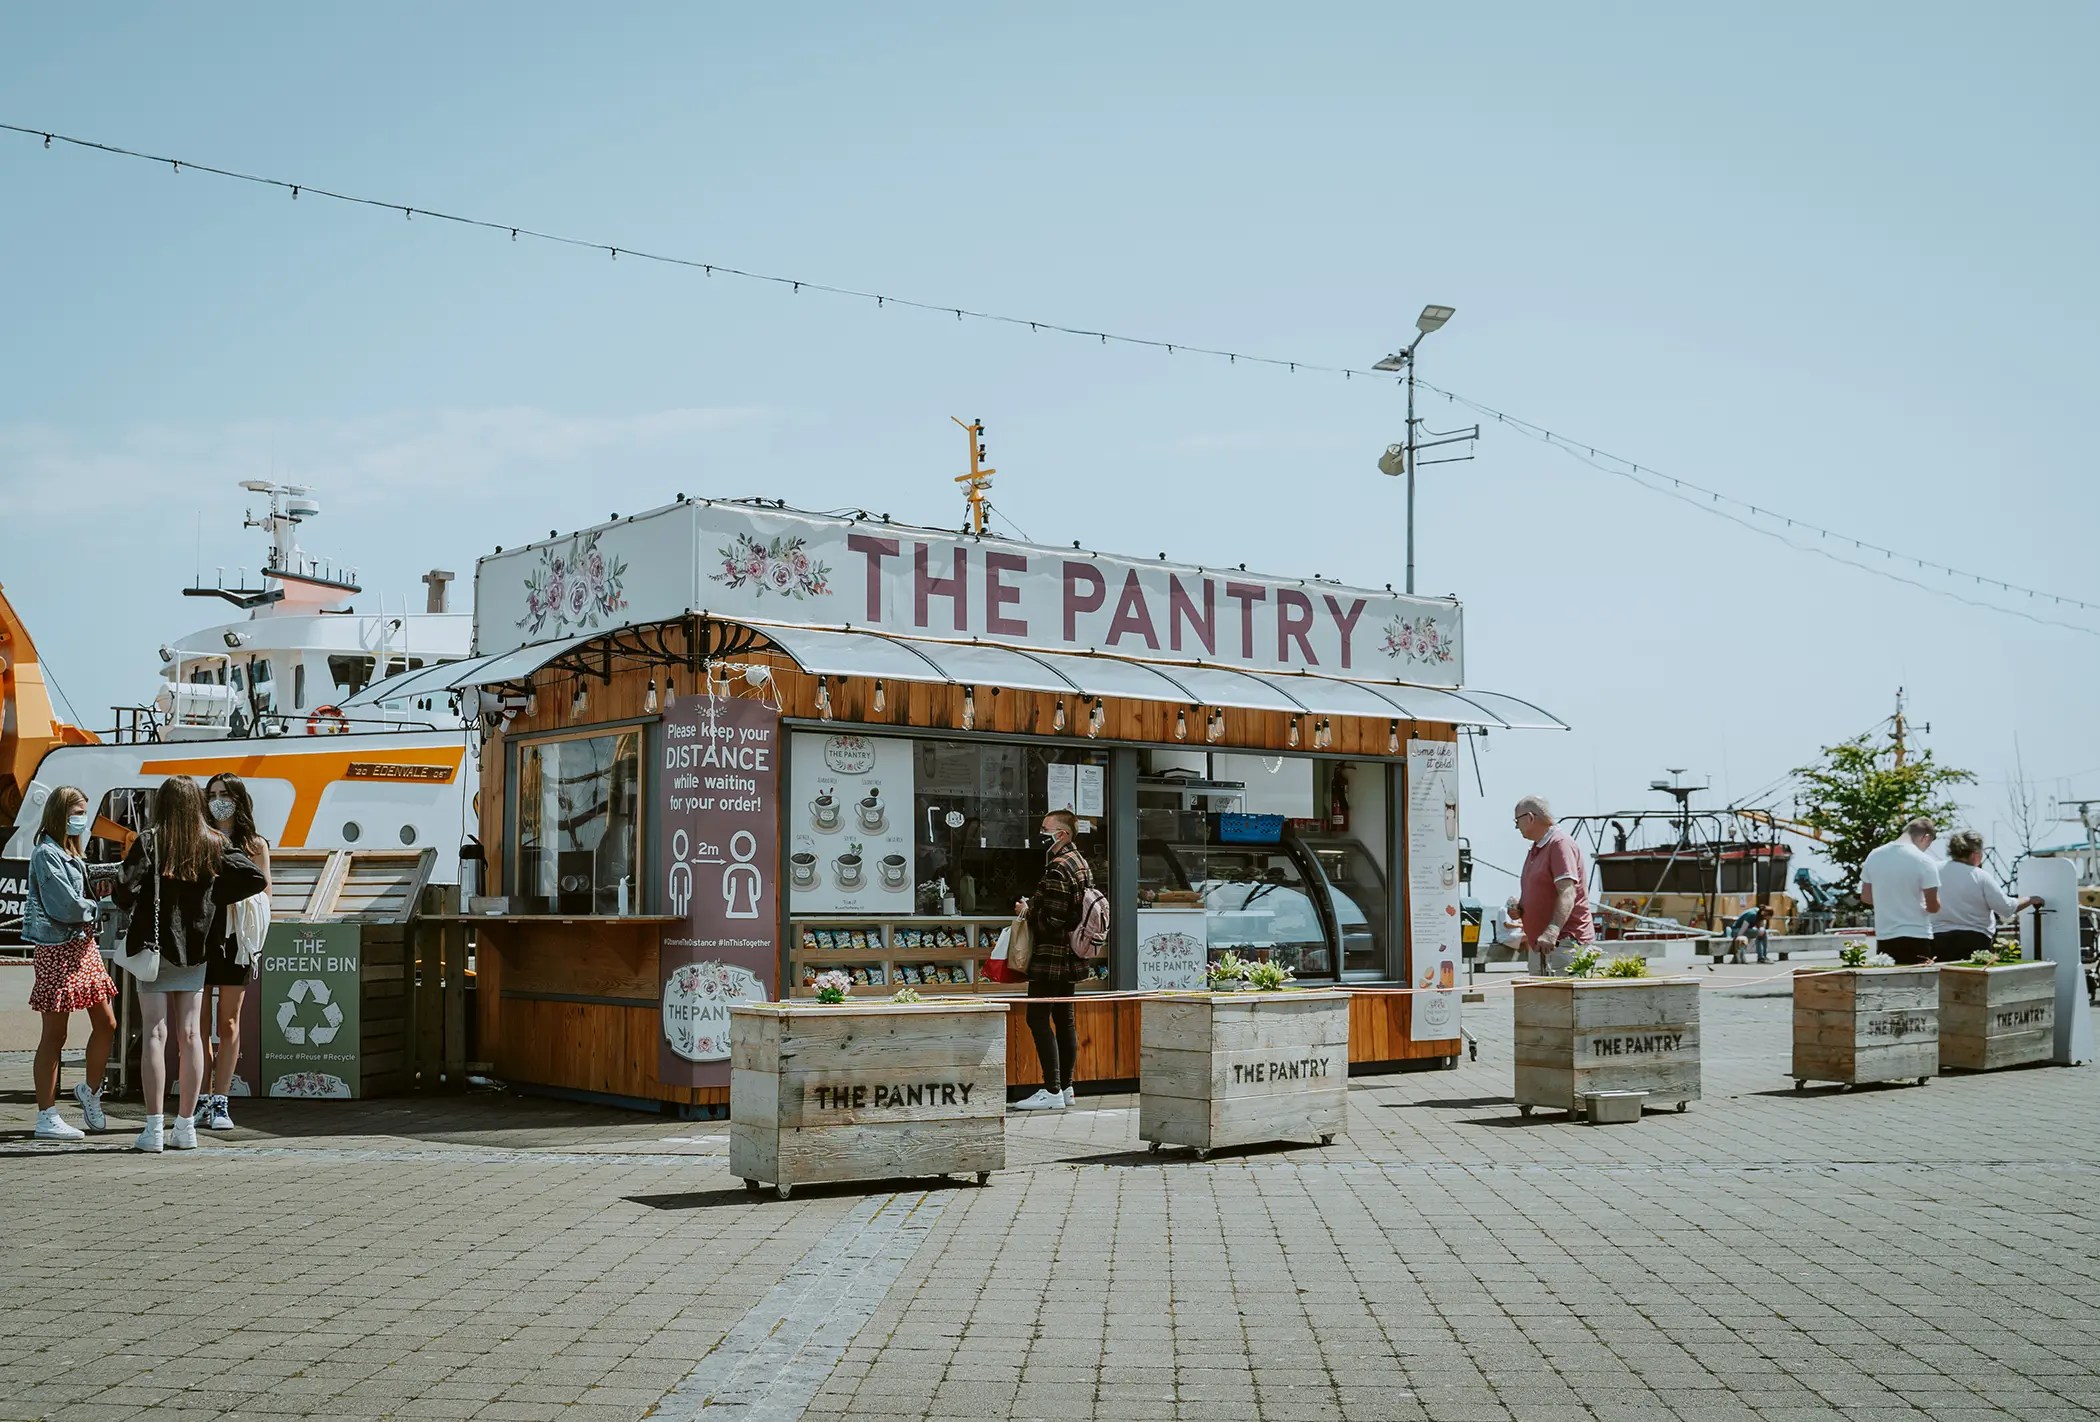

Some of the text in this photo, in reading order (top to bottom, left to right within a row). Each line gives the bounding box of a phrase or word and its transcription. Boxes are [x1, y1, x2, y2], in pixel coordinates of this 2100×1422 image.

[848, 533, 1367, 669] THE PANTRY
[667, 721, 770, 744] Please keep your
[666, 744, 770, 771] DISTANCE
[829, 750, 871, 760] THE PANTRY
[372, 765, 429, 778] EDENVALE
[673, 773, 756, 795] while waiting
[670, 795, 762, 814] for your order!
[698, 842, 719, 856] 2m
[293, 939, 326, 954] THE
[718, 938, 772, 949] #InThisTogether
[264, 957, 357, 972] GREEN BIN
[1142, 960, 1200, 972] THE PANTRY
[668, 1004, 730, 1021] THE PAN
[1996, 1008, 2045, 1027] THE PANTRY
[1593, 1034, 1682, 1056] THE PANTRY
[265, 1053, 356, 1062] #Reduce #Reuse #Recycle
[1234, 1058, 1329, 1084] THE PANTRY
[815, 1083, 974, 1109] THE PANTRY
